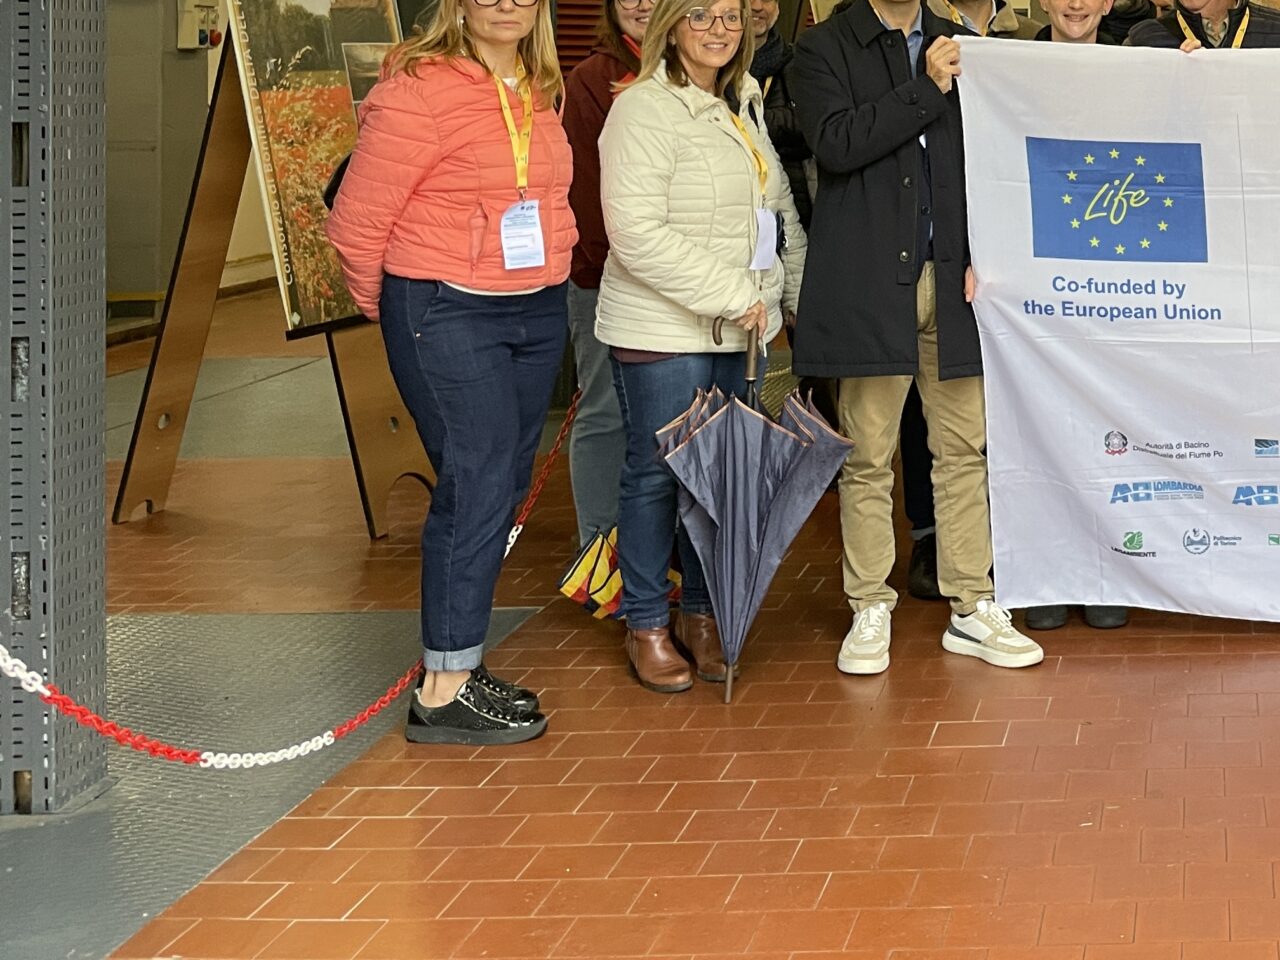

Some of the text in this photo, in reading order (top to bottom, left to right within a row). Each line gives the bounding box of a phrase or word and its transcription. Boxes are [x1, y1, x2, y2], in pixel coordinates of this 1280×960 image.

[237, 10, 250, 42] DEL
[244, 48, 260, 100] DELTA
[1084, 172, 1150, 225] Life
[1051, 275, 1186, 299] Co-funded by
[1024, 300, 1222, 322] the European Union
[1176, 441, 1182, 450] di
[1184, 441, 1210, 449] Bacino
[1213, 450, 1224, 458] Po
[1154, 481, 1204, 492] LOMBARDIA
